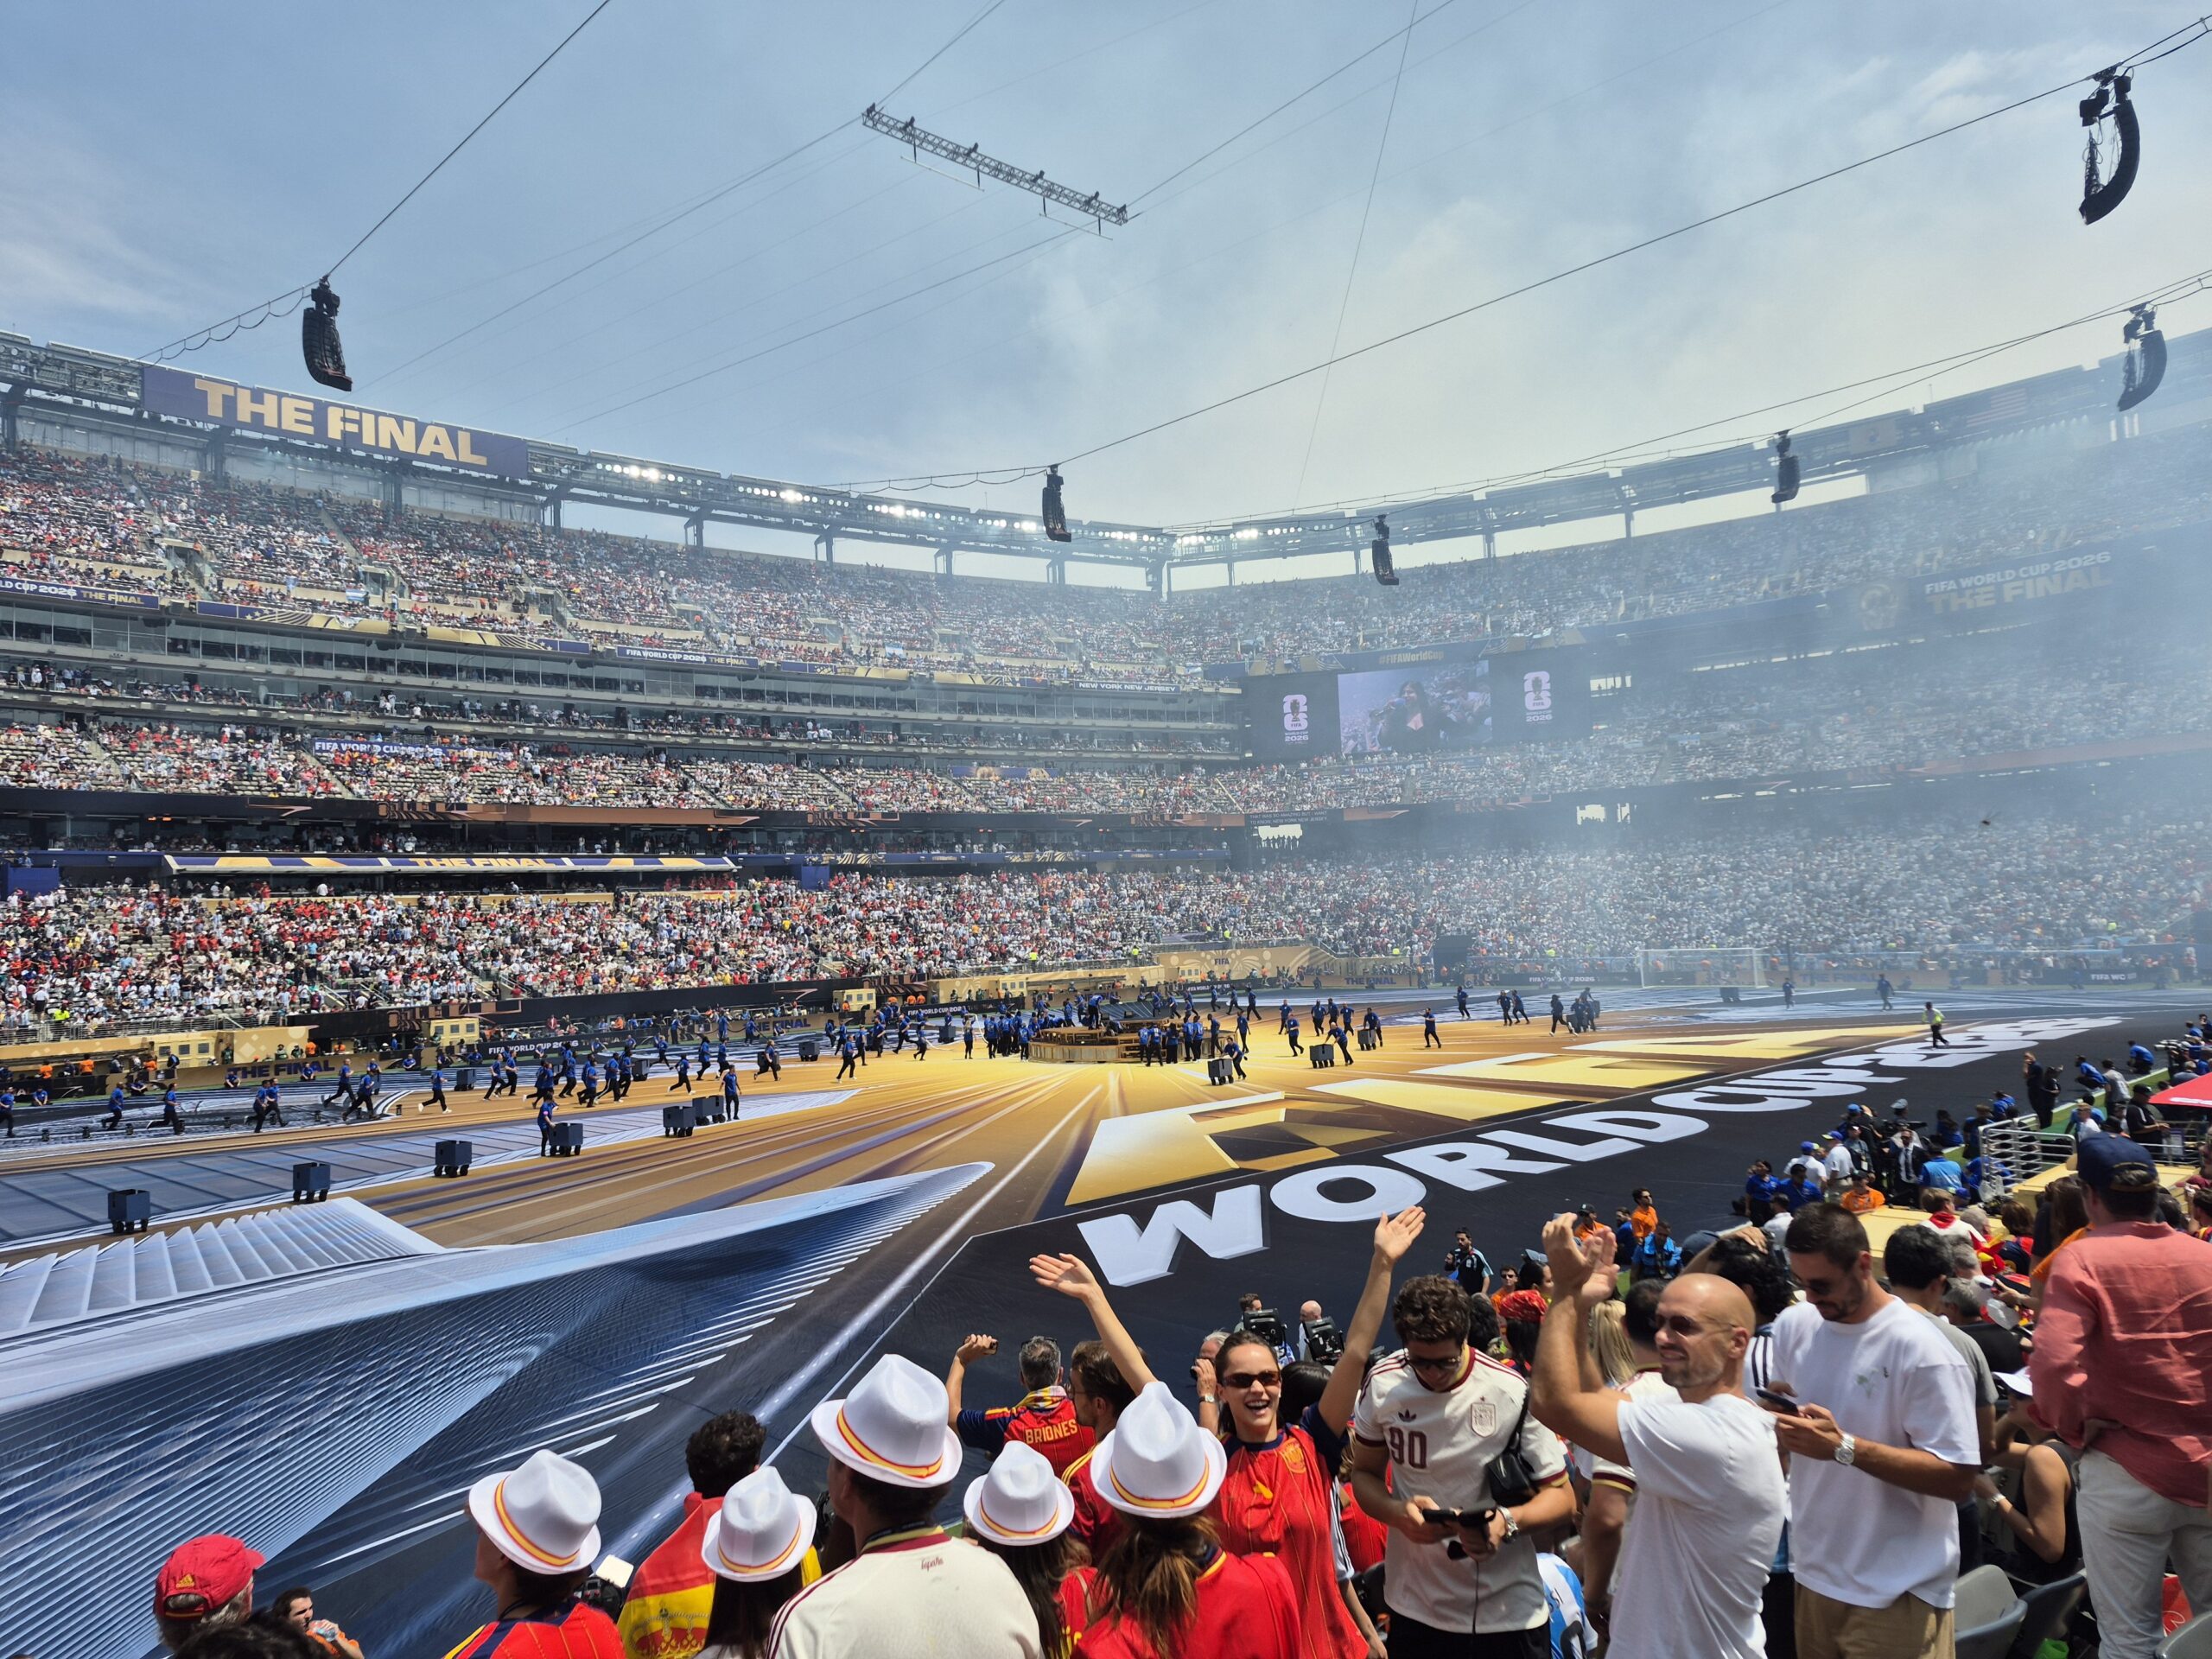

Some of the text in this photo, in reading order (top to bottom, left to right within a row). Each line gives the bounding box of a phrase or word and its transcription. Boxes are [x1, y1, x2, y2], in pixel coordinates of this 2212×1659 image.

[194, 378, 487, 467] THE FINAL
[1924, 551, 2112, 594] FIFA WORLD CUP 2026
[15, 582, 37, 592] CUP
[39, 586, 77, 596] 2026
[81, 590, 105, 601] THE
[108, 594, 145, 605] FINAL
[1925, 566, 2113, 615] THE FINAL
[642, 651, 667, 659] WORLD
[726, 658, 749, 666] FINAL
[1526, 714, 1553, 722] 2026
[408, 858, 556, 868] THE FINAL
[1214, 957, 1230, 966] FIFA
[488, 1046, 505, 1055] FIFA
[1077, 1016, 2125, 1287] WORLD CUP 2026
[1025, 1418, 1078, 1445] BRIONES
[1389, 1427, 1427, 1469] 90
